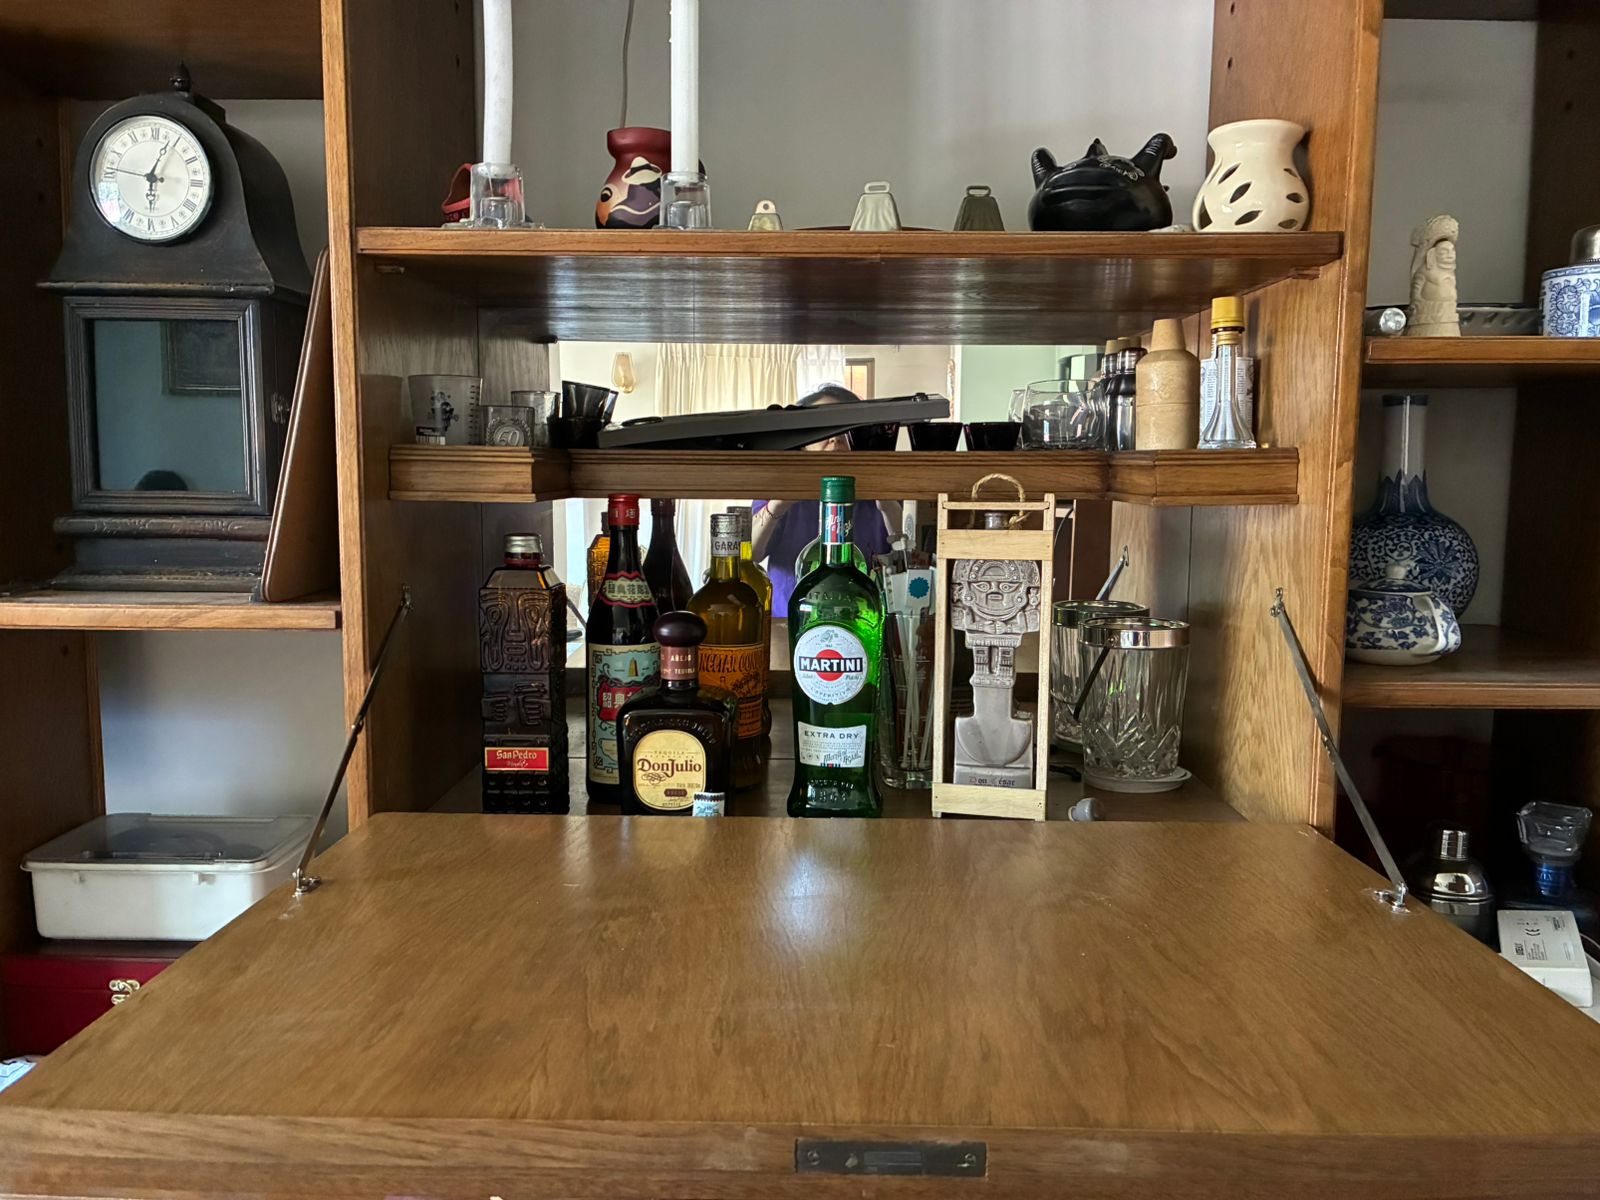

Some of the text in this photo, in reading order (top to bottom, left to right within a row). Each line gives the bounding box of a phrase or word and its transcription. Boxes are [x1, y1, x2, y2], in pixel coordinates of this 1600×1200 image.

[714, 541, 741, 551] GARA
[800, 657, 861, 672] MARTINI
[804, 730, 860, 740] EXTRA DRY
[496, 749, 538, 760] San Pedro
